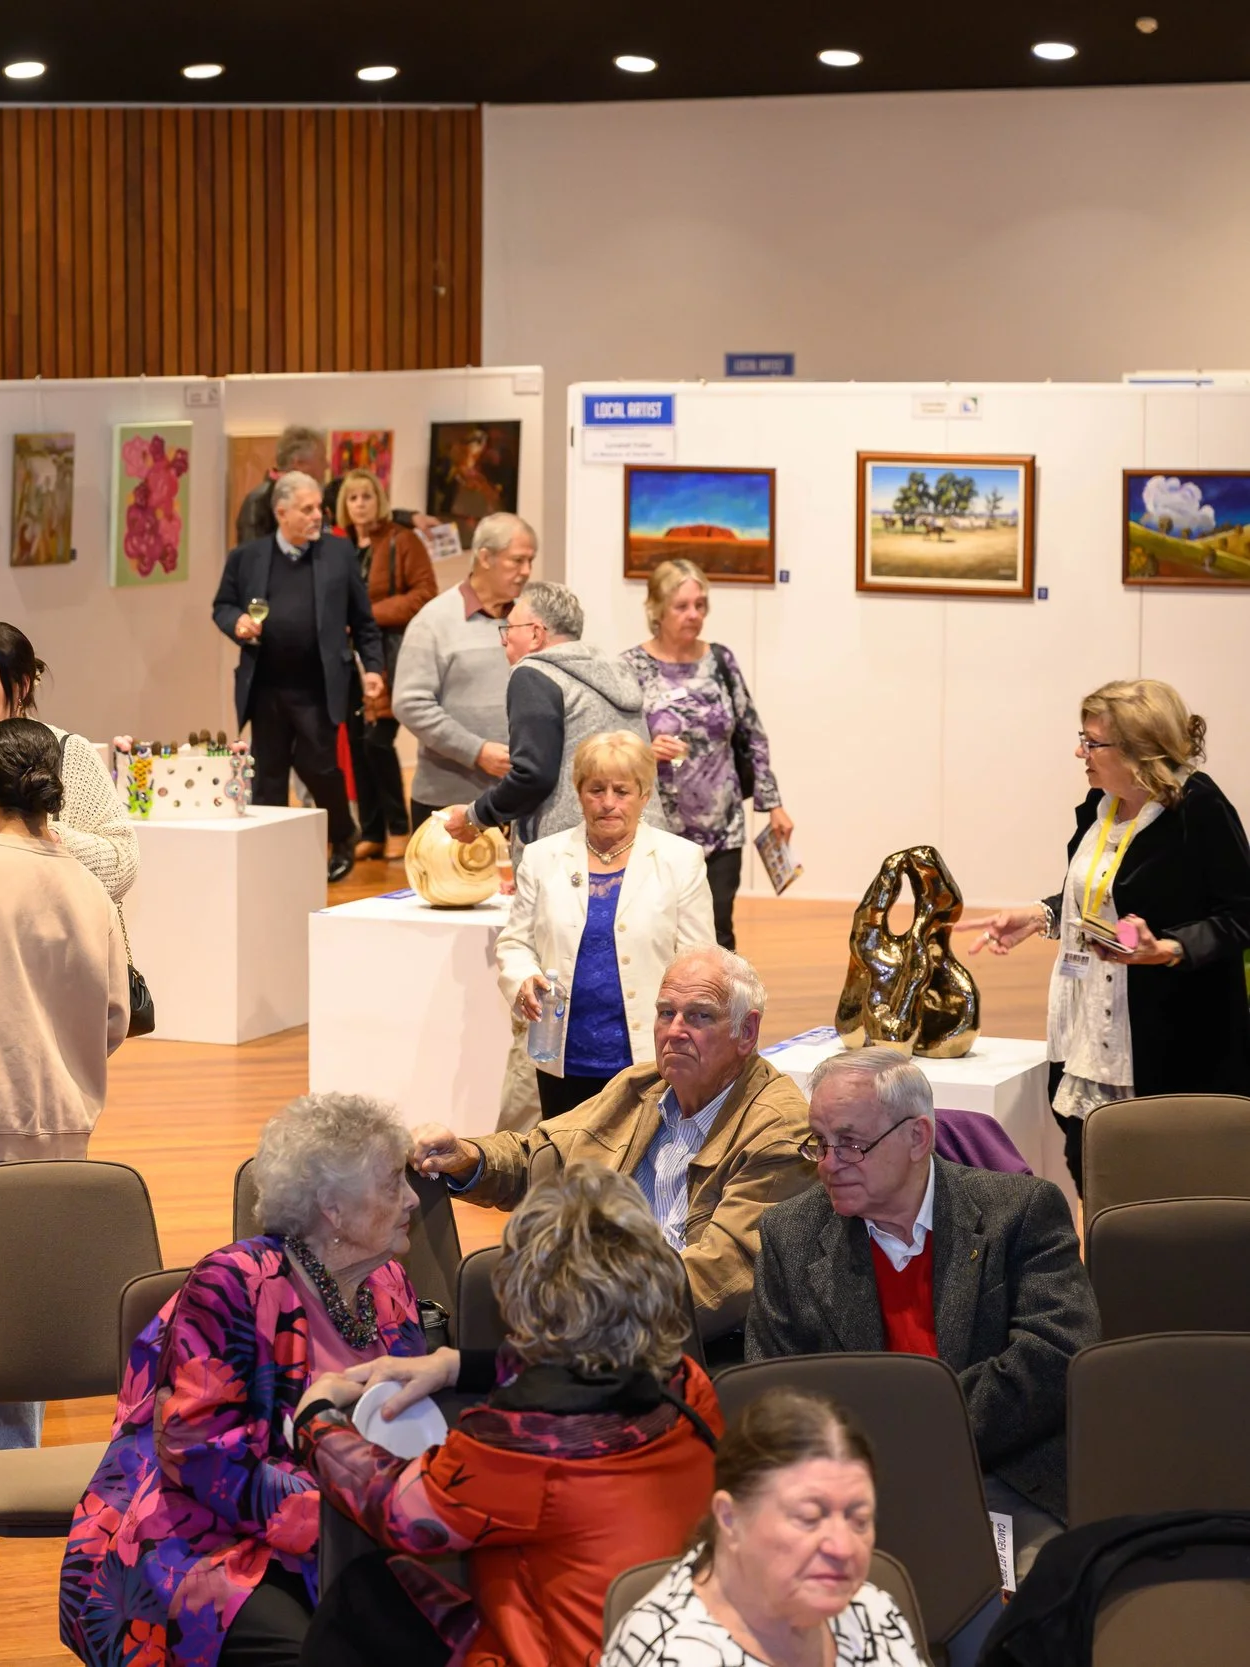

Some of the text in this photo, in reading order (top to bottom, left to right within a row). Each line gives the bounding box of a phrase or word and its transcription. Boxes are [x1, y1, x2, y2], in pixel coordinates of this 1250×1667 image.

[594, 401, 663, 419] LOCAL ARTIST
[997, 1523, 1007, 1551] CAMDEN
[997, 1553, 1007, 1568] ART
